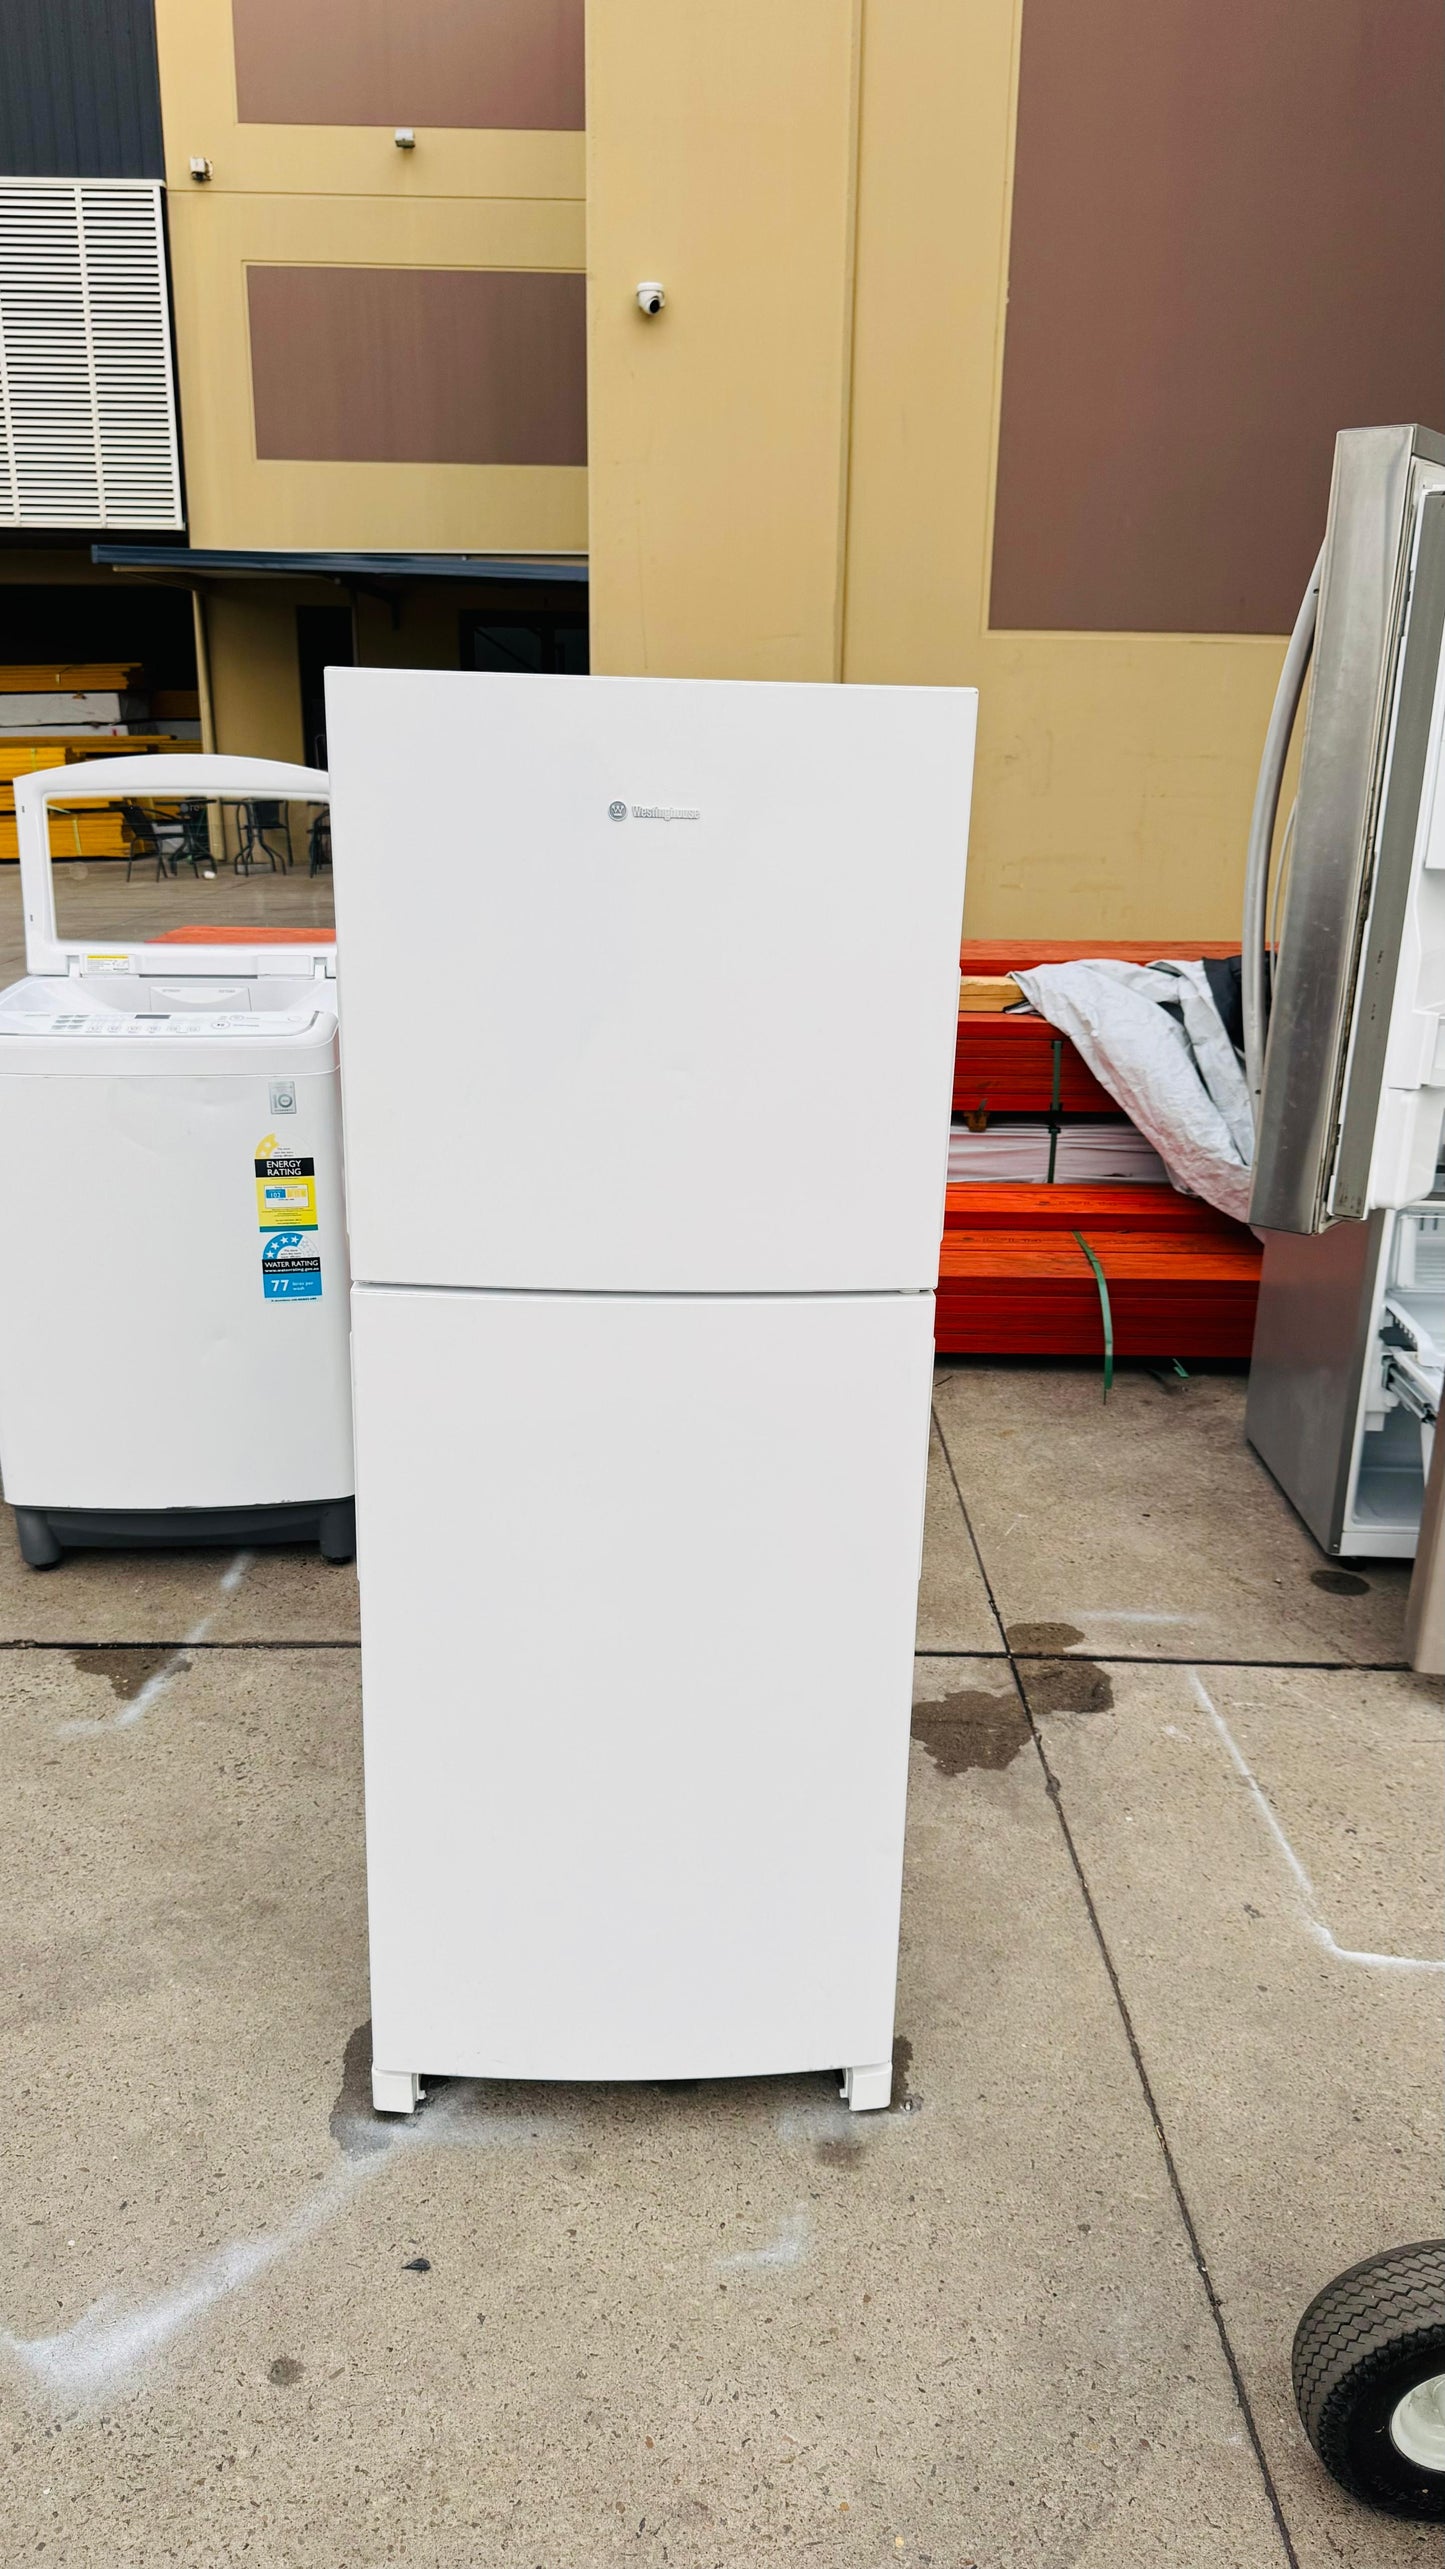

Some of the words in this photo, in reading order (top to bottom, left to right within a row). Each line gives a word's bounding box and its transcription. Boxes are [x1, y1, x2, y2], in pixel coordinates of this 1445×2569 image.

[266, 1160, 302, 1168] ENERGY
[267, 1168, 302, 1176] RATING
[271, 1280, 289, 1292] 77
